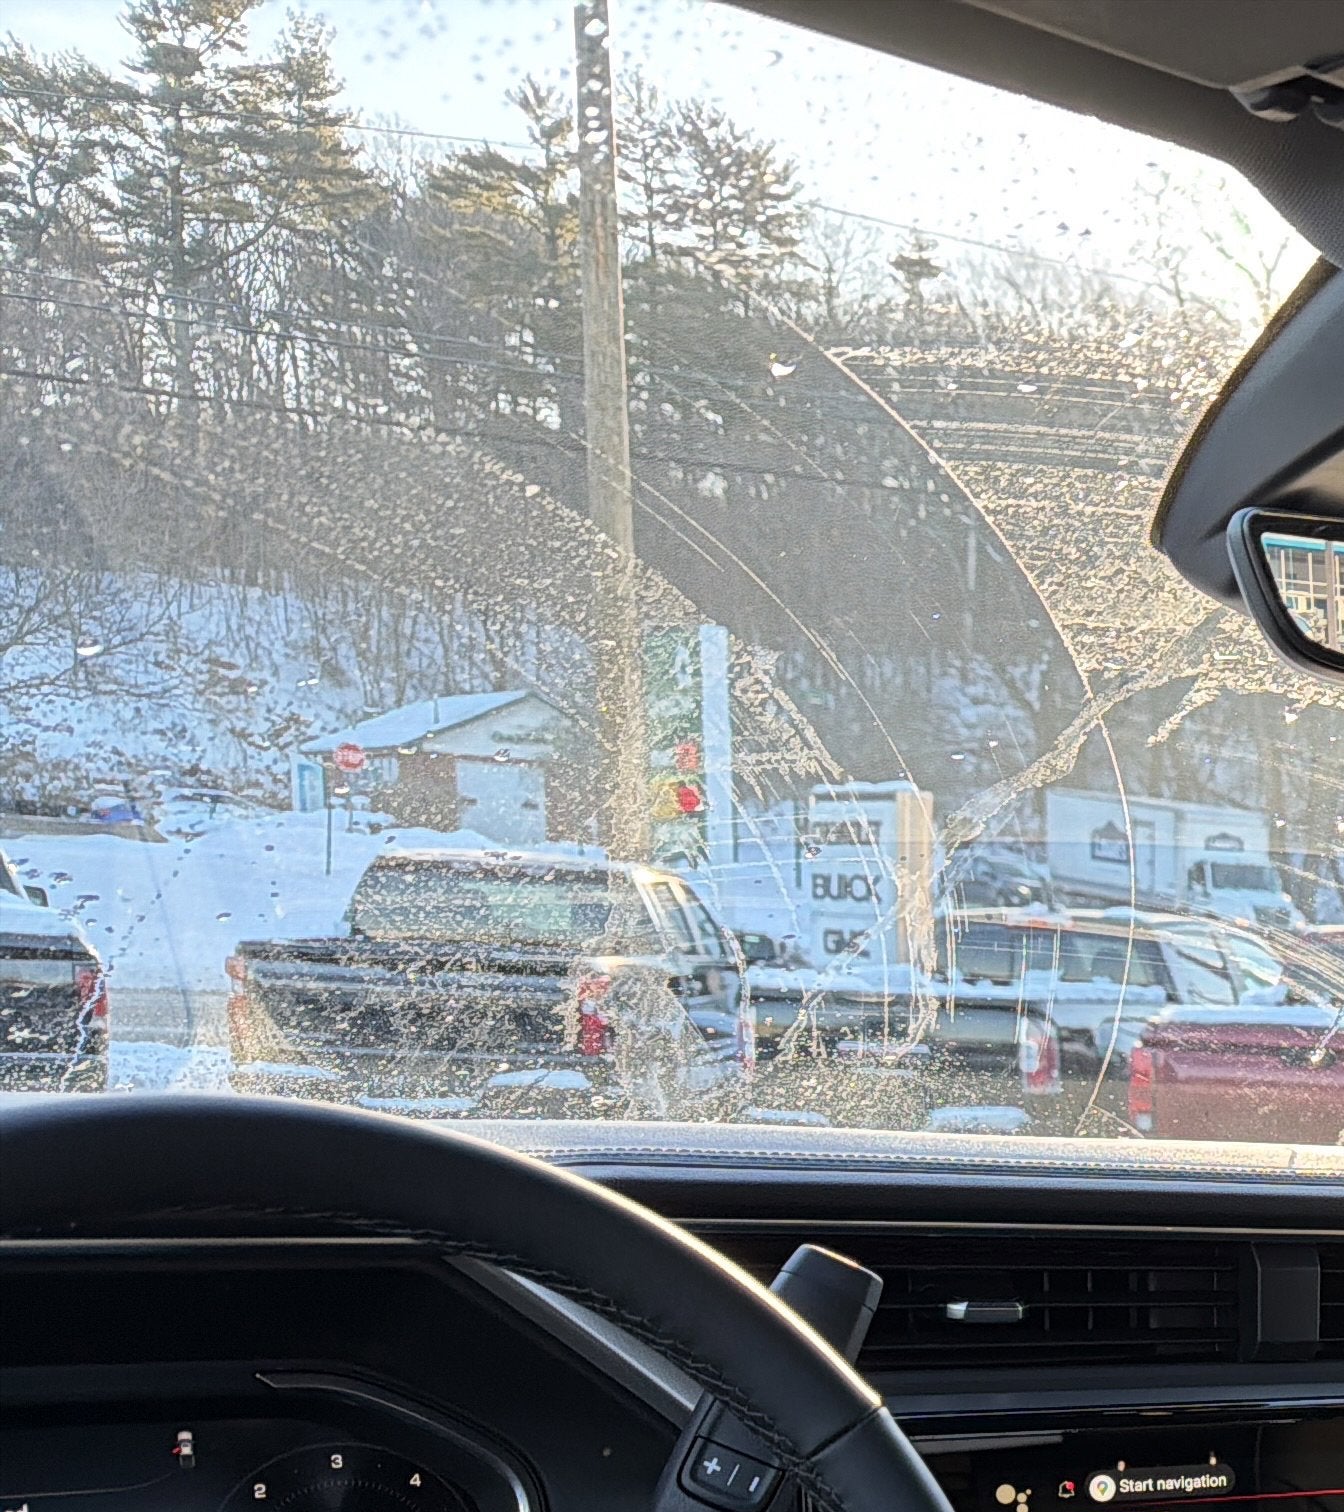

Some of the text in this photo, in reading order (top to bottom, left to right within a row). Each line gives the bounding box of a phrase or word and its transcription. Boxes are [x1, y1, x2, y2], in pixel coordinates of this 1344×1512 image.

[811, 873, 882, 905] BUICK
[330, 1453, 343, 1469] 3
[408, 1473, 422, 1488] 4
[1119, 1474, 1227, 1493] Start navigation
[253, 1483, 268, 1499] 2
